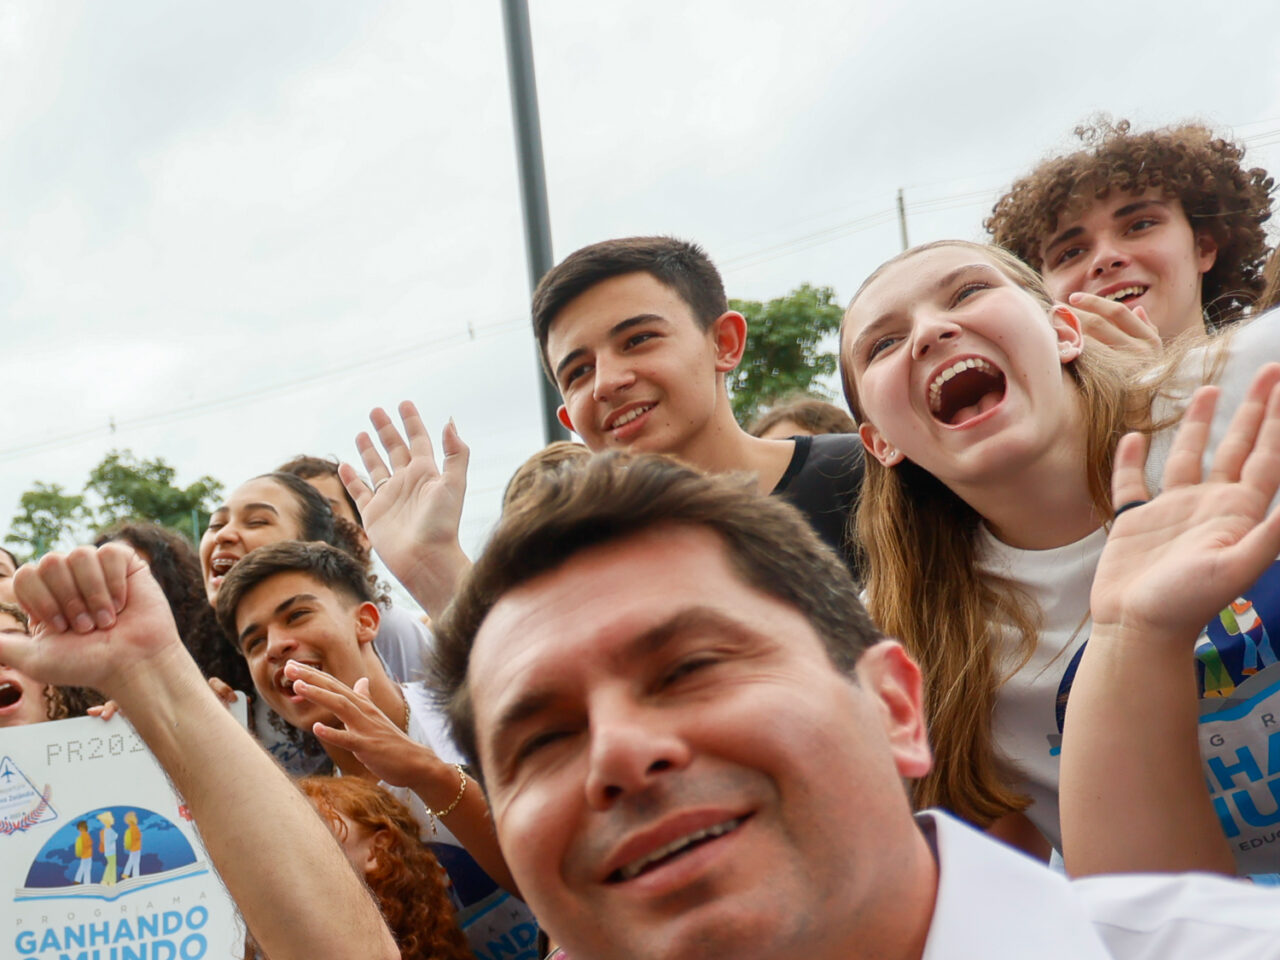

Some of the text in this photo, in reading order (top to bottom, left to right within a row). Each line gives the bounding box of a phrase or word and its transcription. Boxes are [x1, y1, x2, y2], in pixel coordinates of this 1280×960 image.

[46, 733, 145, 766] PR202
[1239, 830, 1280, 851] EDUC
[15, 905, 209, 955] GANHANDO
